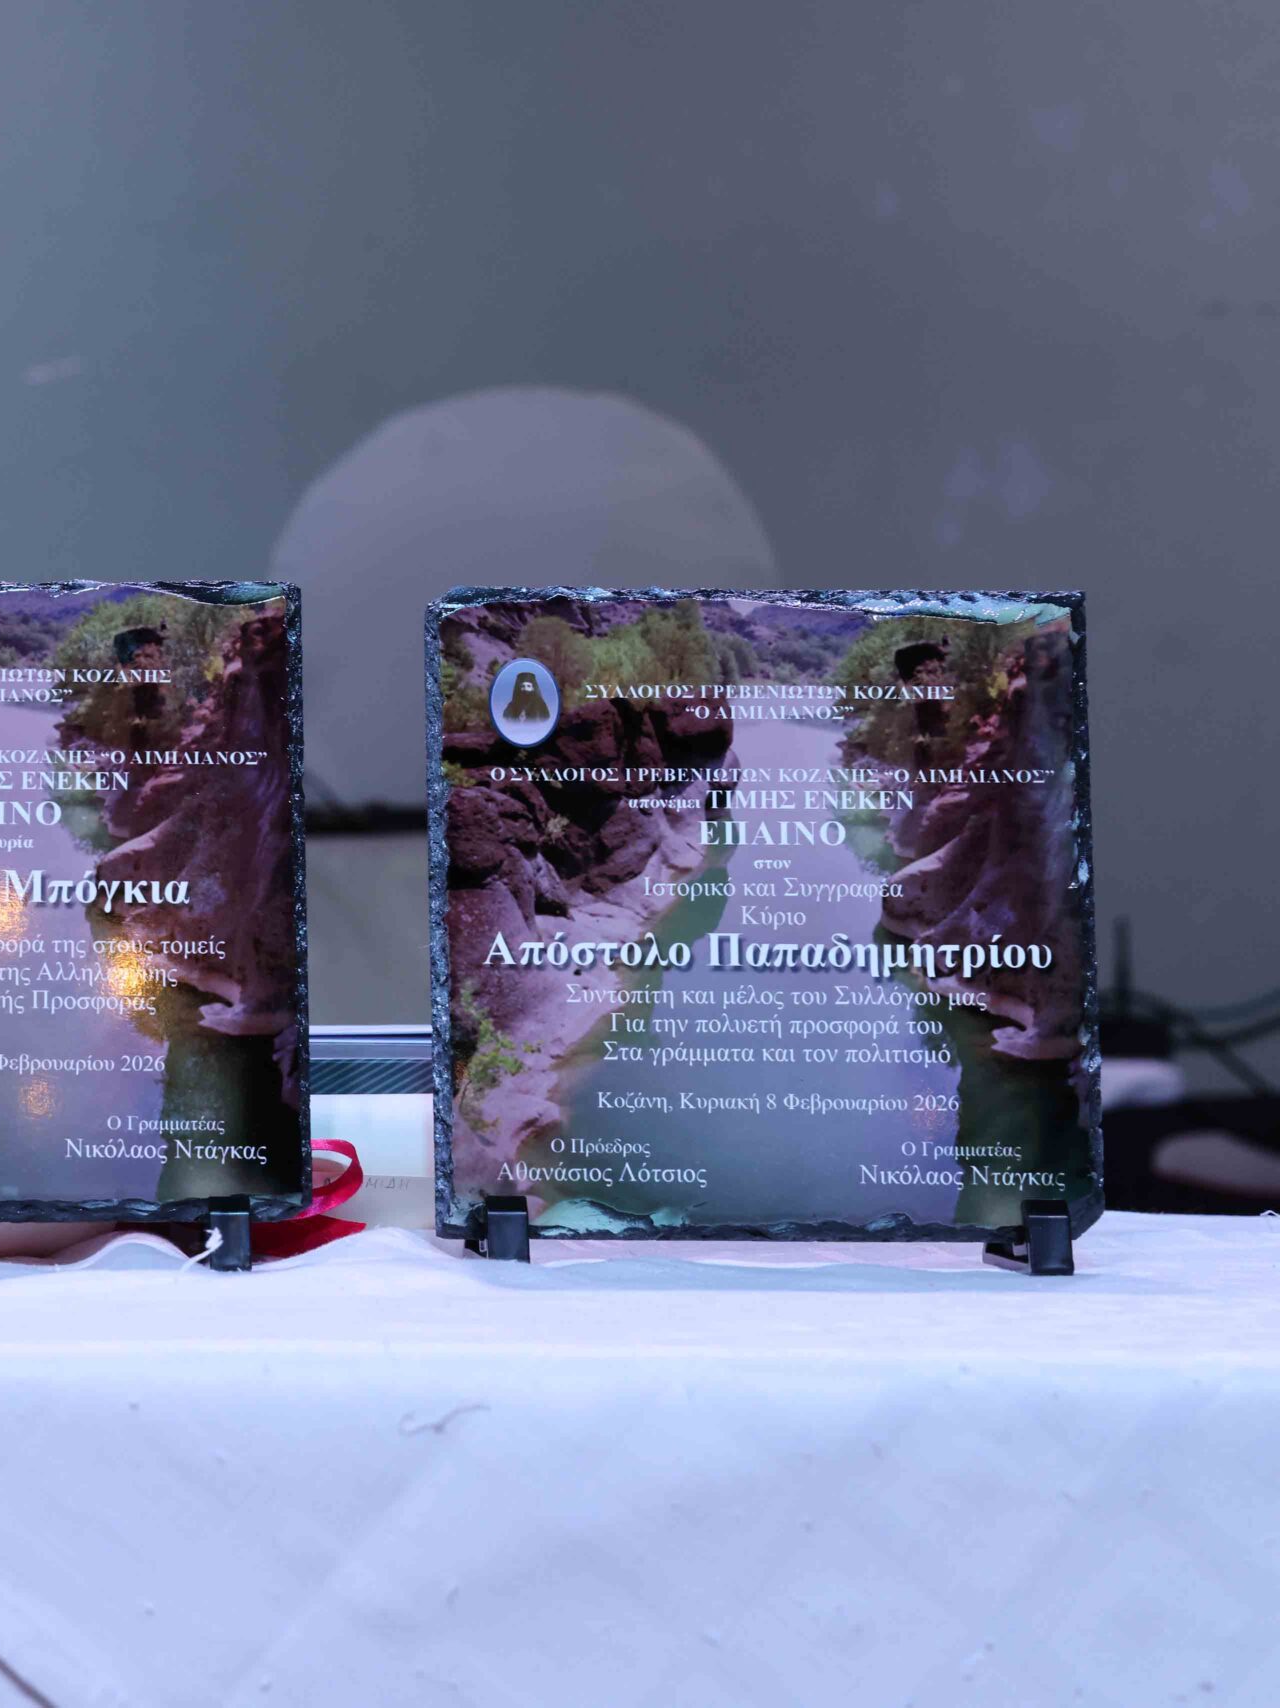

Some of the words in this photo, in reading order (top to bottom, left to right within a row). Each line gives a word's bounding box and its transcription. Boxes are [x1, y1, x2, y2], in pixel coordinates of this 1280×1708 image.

[73, 669, 171, 683] ΚΟΖΑΝΗΣ
[585, 684, 694, 699] ΣΥΛΛΟΓΟΣ
[700, 684, 847, 700] ΓΡΕΒΕΝΙΩΤΩΝ
[853, 685, 955, 700] ΚΟΖΑΝΗΣ
[21, 771, 129, 791] ΕΝΕΚΕΝ
[510, 767, 619, 782] ΣΥΛΛΟΓΟΣ
[624, 767, 771, 783] ΓΡΕΒΕΝΙΩΤΩΝ
[779, 768, 879, 783] ΚΟΖΑΝΗΣ
[628, 795, 701, 813] απονέμει
[705, 790, 796, 810] ΤΙΜΗΣ
[803, 790, 914, 811] ΕΝΕΚΕΝ
[697, 820, 847, 846] ΕΠΑΙΝΟ
[753, 859, 792, 870] στον
[4, 869, 190, 913] Μπόγκια
[644, 877, 736, 901] Ιστορικό
[743, 881, 777, 897] και
[783, 877, 903, 901] Συγγραφέα
[740, 905, 806, 930] Κύριο
[51, 939, 87, 958] της
[92, 939, 153, 959] στους
[160, 935, 226, 959] τομείς
[483, 931, 691, 967] Απόστολο
[706, 933, 1052, 978] Παπαδημητρίου
[566, 983, 675, 1008] Συντοπίτη
[682, 988, 715, 1005] και
[723, 985, 784, 1010] μέλος
[790, 989, 827, 1005] του
[834, 985, 940, 1010] Συλλόγου
[948, 991, 987, 1011] μας
[610, 1012, 645, 1033] Για
[652, 1018, 688, 1038] την
[695, 1013, 782, 1038] πολυετή
[789, 1014, 899, 1039] προσφορά
[905, 1019, 943, 1035] του
[120, 1055, 166, 1072] 2026
[603, 1041, 643, 1061] Στα
[649, 1042, 755, 1067] γράμματα
[762, 1048, 796, 1063] και
[803, 1048, 838, 1063] τον
[845, 1043, 951, 1068] πολιτισμό
[597, 1092, 673, 1112] Κοζάνη,
[679, 1092, 760, 1114] Κυριακή
[766, 1094, 777, 1110] 8
[783, 1093, 908, 1115] Φεβρουαρίου
[914, 1095, 959, 1112] 2026
[127, 1115, 225, 1134] Γραμματέας
[65, 1138, 168, 1163] Νικόλαος
[174, 1139, 267, 1164] Ντάγκας
[570, 1138, 651, 1158] Πρόεδρος
[922, 1141, 1022, 1161] Γραμματέας
[497, 1161, 613, 1187] Αθανάσιος
[618, 1161, 707, 1188] Λότσιος
[859, 1164, 964, 1190] Νικόλαος
[970, 1165, 1065, 1191] Ντάγκας
